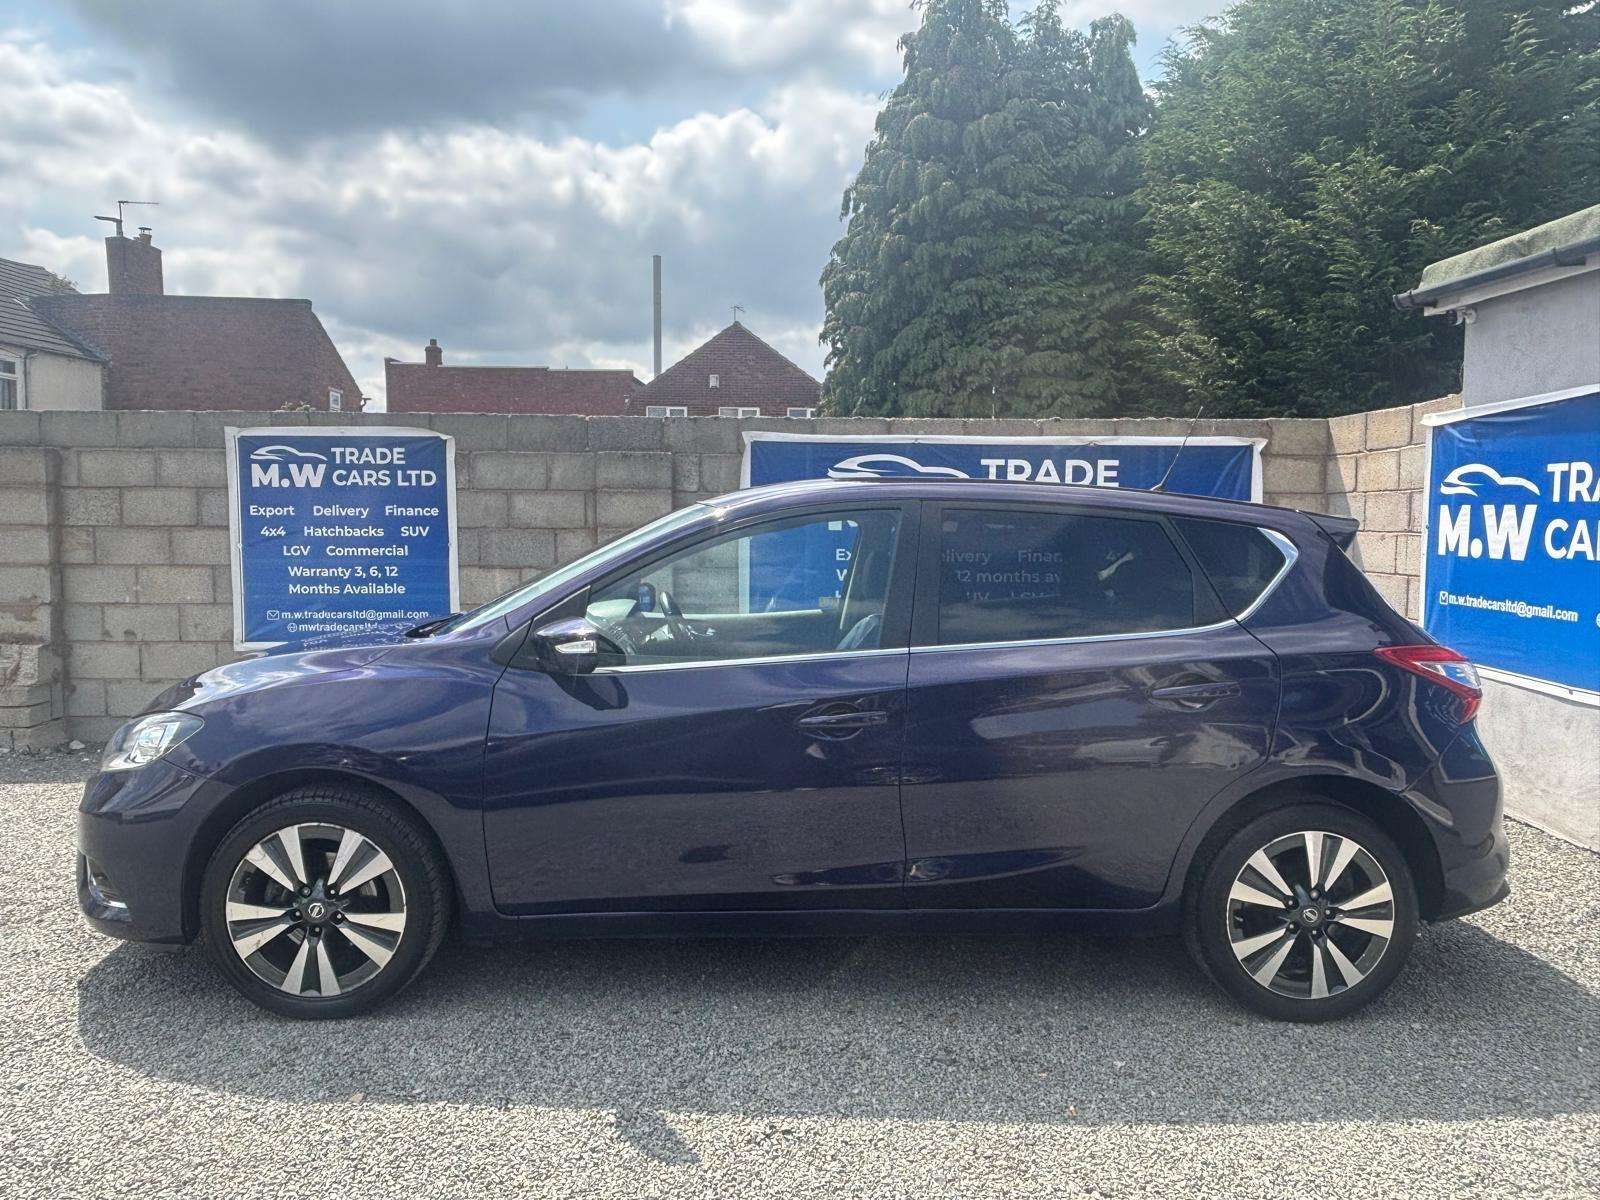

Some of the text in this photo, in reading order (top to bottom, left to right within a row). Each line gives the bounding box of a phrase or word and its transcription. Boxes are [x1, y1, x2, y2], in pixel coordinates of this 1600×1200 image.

[330, 447, 406, 464] TRADE
[251, 463, 327, 488] M.W
[332, 469, 437, 487] CARS LTD
[980, 458, 1120, 487] TRADE
[249, 504, 440, 518] Export Delivery Finance
[260, 525, 430, 537] 4x4 Hatchbacks SUV
[1437, 503, 1538, 561] M.W
[283, 544, 409, 556] LGV Commercial
[287, 565, 399, 578] Warranty 3, 6, 12
[976, 570, 1039, 583] months
[288, 583, 406, 594] Months Available
[1448, 593, 1578, 622] m.w.tradecarsltd@gmail.com
[281, 609, 429, 621] m.w.tradecarsltd@gmail.com
